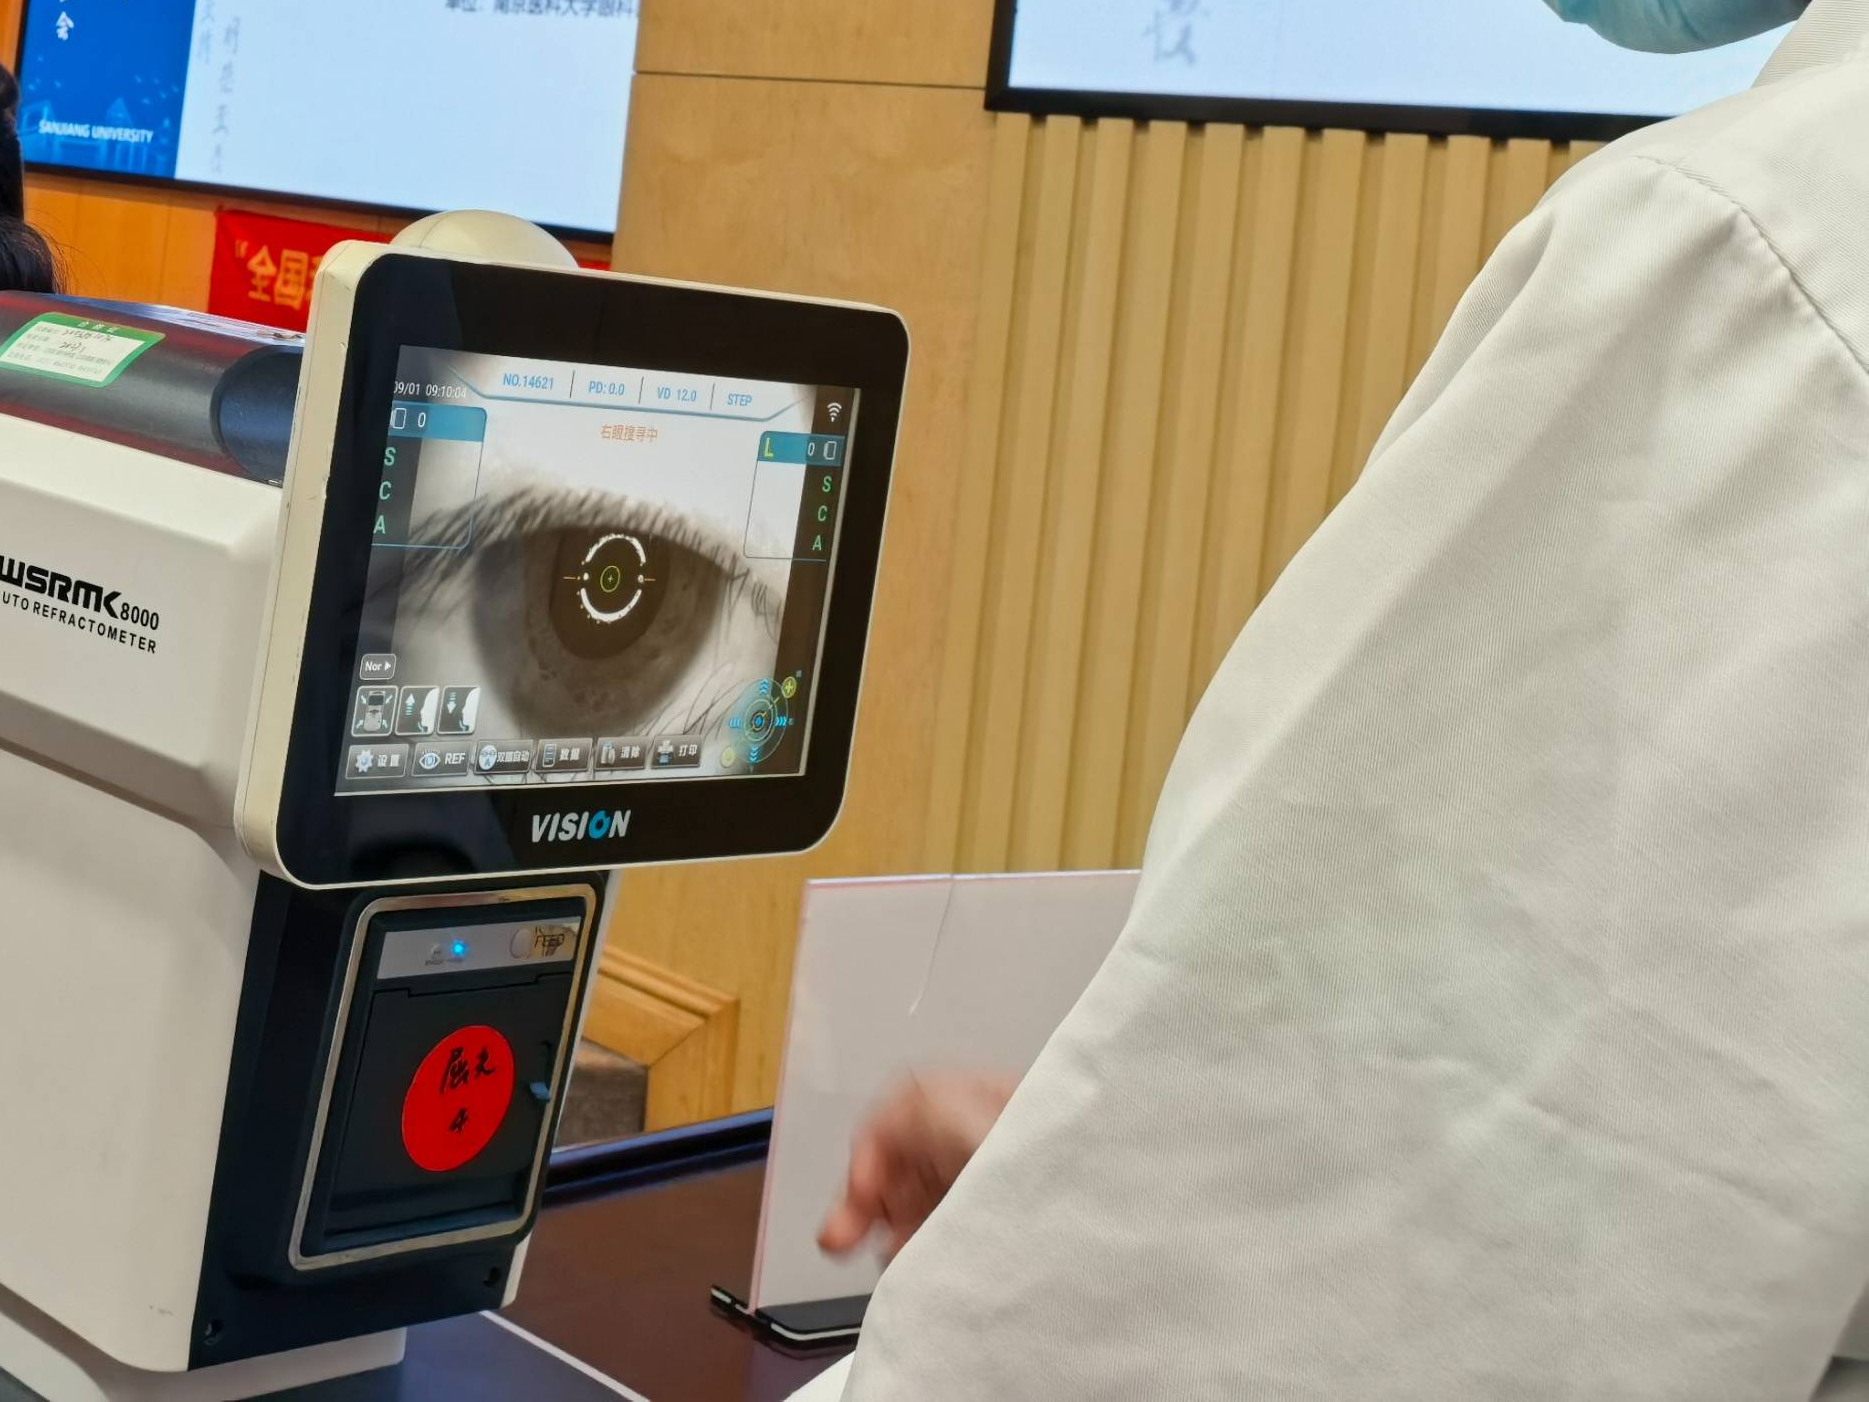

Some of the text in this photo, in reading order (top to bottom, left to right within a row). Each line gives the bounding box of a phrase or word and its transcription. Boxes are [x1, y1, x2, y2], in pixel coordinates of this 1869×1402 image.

[91, 125, 154, 144] UNIVERSITY
[235, 238, 321, 311] “全国
[425, 383, 467, 399] 09:10:04
[502, 372, 555, 391] NO.14621
[676, 388, 697, 403] 12.0
[727, 393, 753, 407] STEP
[600, 423, 658, 443] 右眼搜寻中
[384, 446, 397, 467] S
[764, 437, 775, 458] L
[379, 481, 392, 501] C
[822, 475, 832, 493] S
[818, 505, 828, 522] C
[373, 514, 386, 535] A
[812, 534, 823, 552] A
[32, 600, 157, 655] REFRACTOMETER
[364, 660, 383, 673] Nor
[444, 752, 466, 766] REF
[677, 742, 698, 757] 打印
[531, 809, 632, 844] VISION
